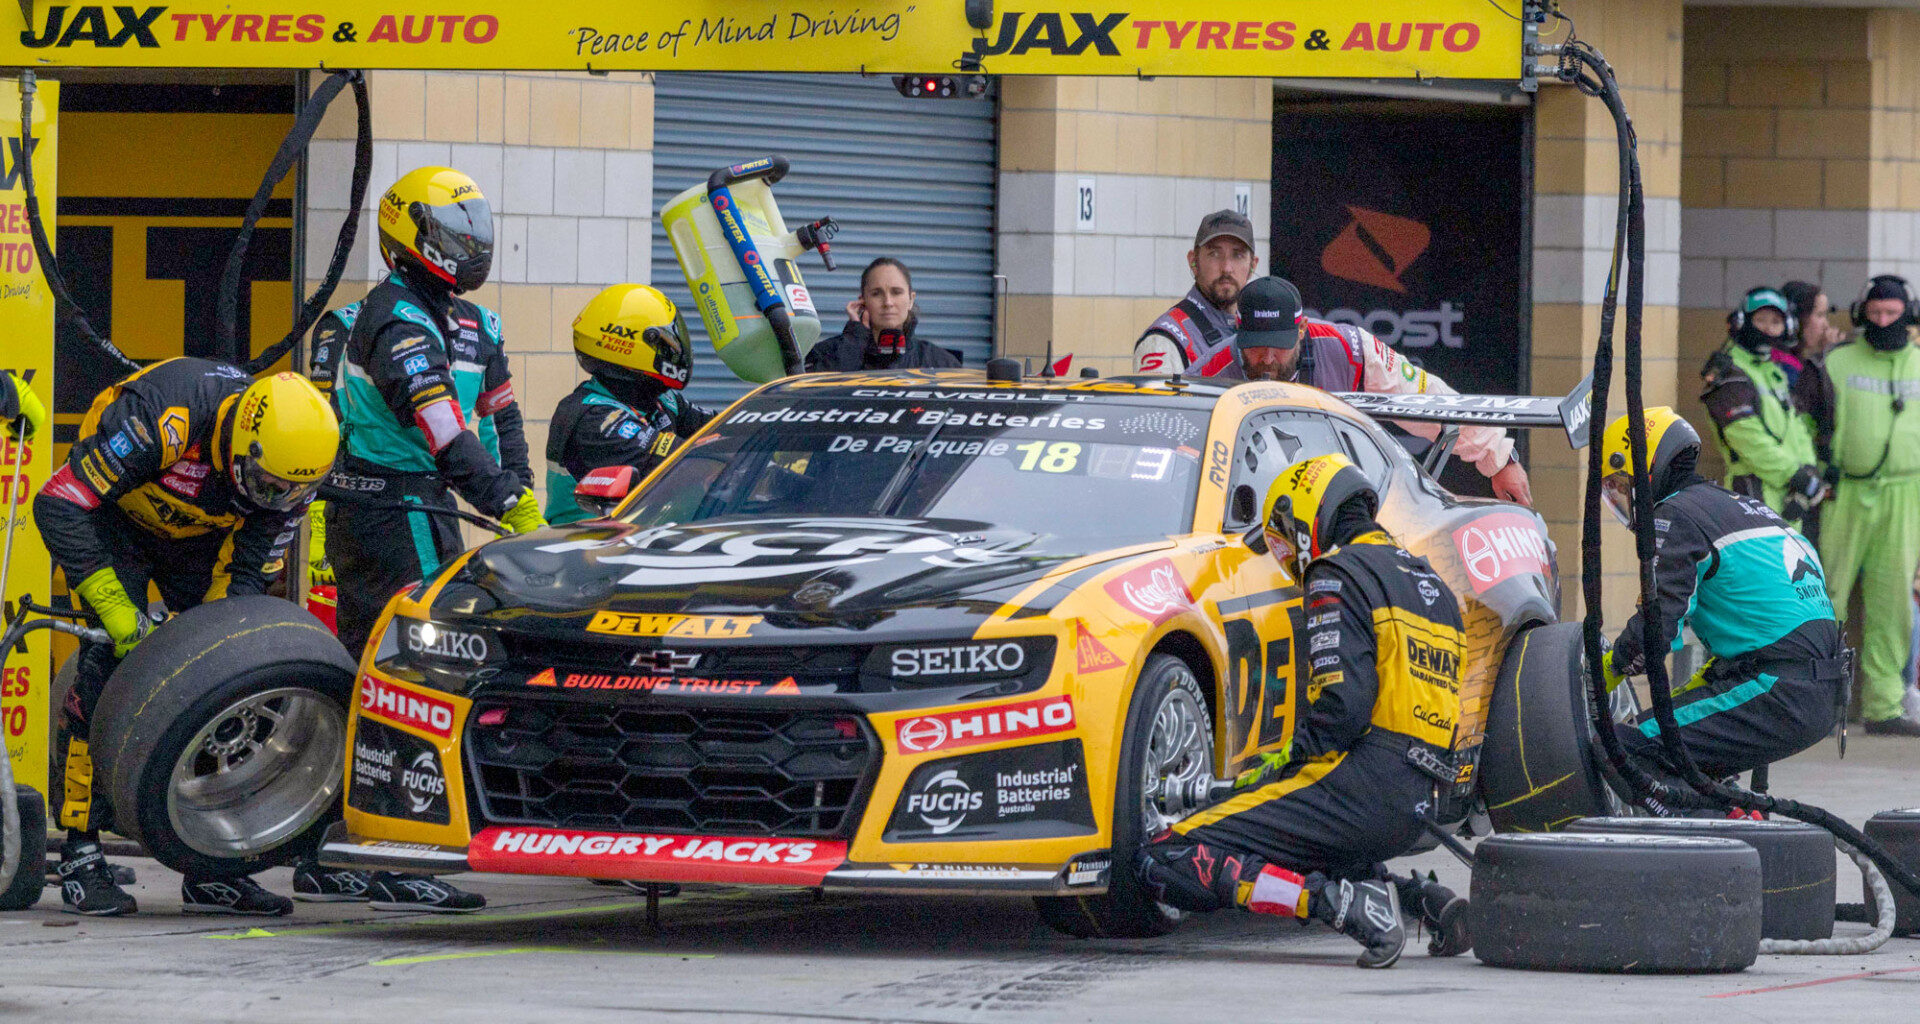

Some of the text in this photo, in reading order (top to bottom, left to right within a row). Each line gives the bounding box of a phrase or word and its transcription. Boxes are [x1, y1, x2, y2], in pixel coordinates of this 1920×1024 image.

[20, 6, 499, 48] JAX TYRES & AUTO
[656, 20, 690, 58] of
[694, 12, 777, 48] Mind
[972, 12, 1482, 56] JAX TYRES & AUTO
[740, 158, 770, 171] PIRTEK
[384, 189, 406, 212] JAX
[1078, 185, 1094, 224] 13
[720, 209, 747, 245] PIRTEK
[752, 263, 779, 298] PIRTEK
[600, 323, 641, 340] JAX
[1302, 302, 1465, 348] oost
[601, 334, 635, 349] TYRES
[603, 343, 633, 356] AUTO
[405, 356, 429, 372] PPG
[852, 388, 1095, 402] CHEVROLET
[1392, 395, 1540, 410] GYM
[251, 394, 268, 436] JAX
[725, 406, 1106, 430] Industrial Batteries
[1373, 405, 1517, 421] AUSTRALIA
[1568, 396, 1591, 434] JAX
[828, 435, 869, 452] De
[1015, 439, 1082, 473] 18
[287, 467, 319, 476] JAX
[1209, 440, 1229, 490] RYCO
[1290, 460, 1314, 491] JAX
[1488, 526, 1549, 566] HINO
[891, 642, 1024, 677] SEIKO
[1079, 634, 1115, 669] Sika
[563, 673, 761, 694] BUILDING TRUST
[375, 688, 453, 731] HINO
[951, 701, 1072, 740] HINO
[355, 758, 392, 783] Batteries
[402, 769, 445, 796] FUCHS
[907, 790, 984, 814] FUCHS
[996, 785, 1071, 805] Batteries
[998, 803, 1036, 815] Australia
[492, 830, 818, 865] HUNGRY JACK'S
